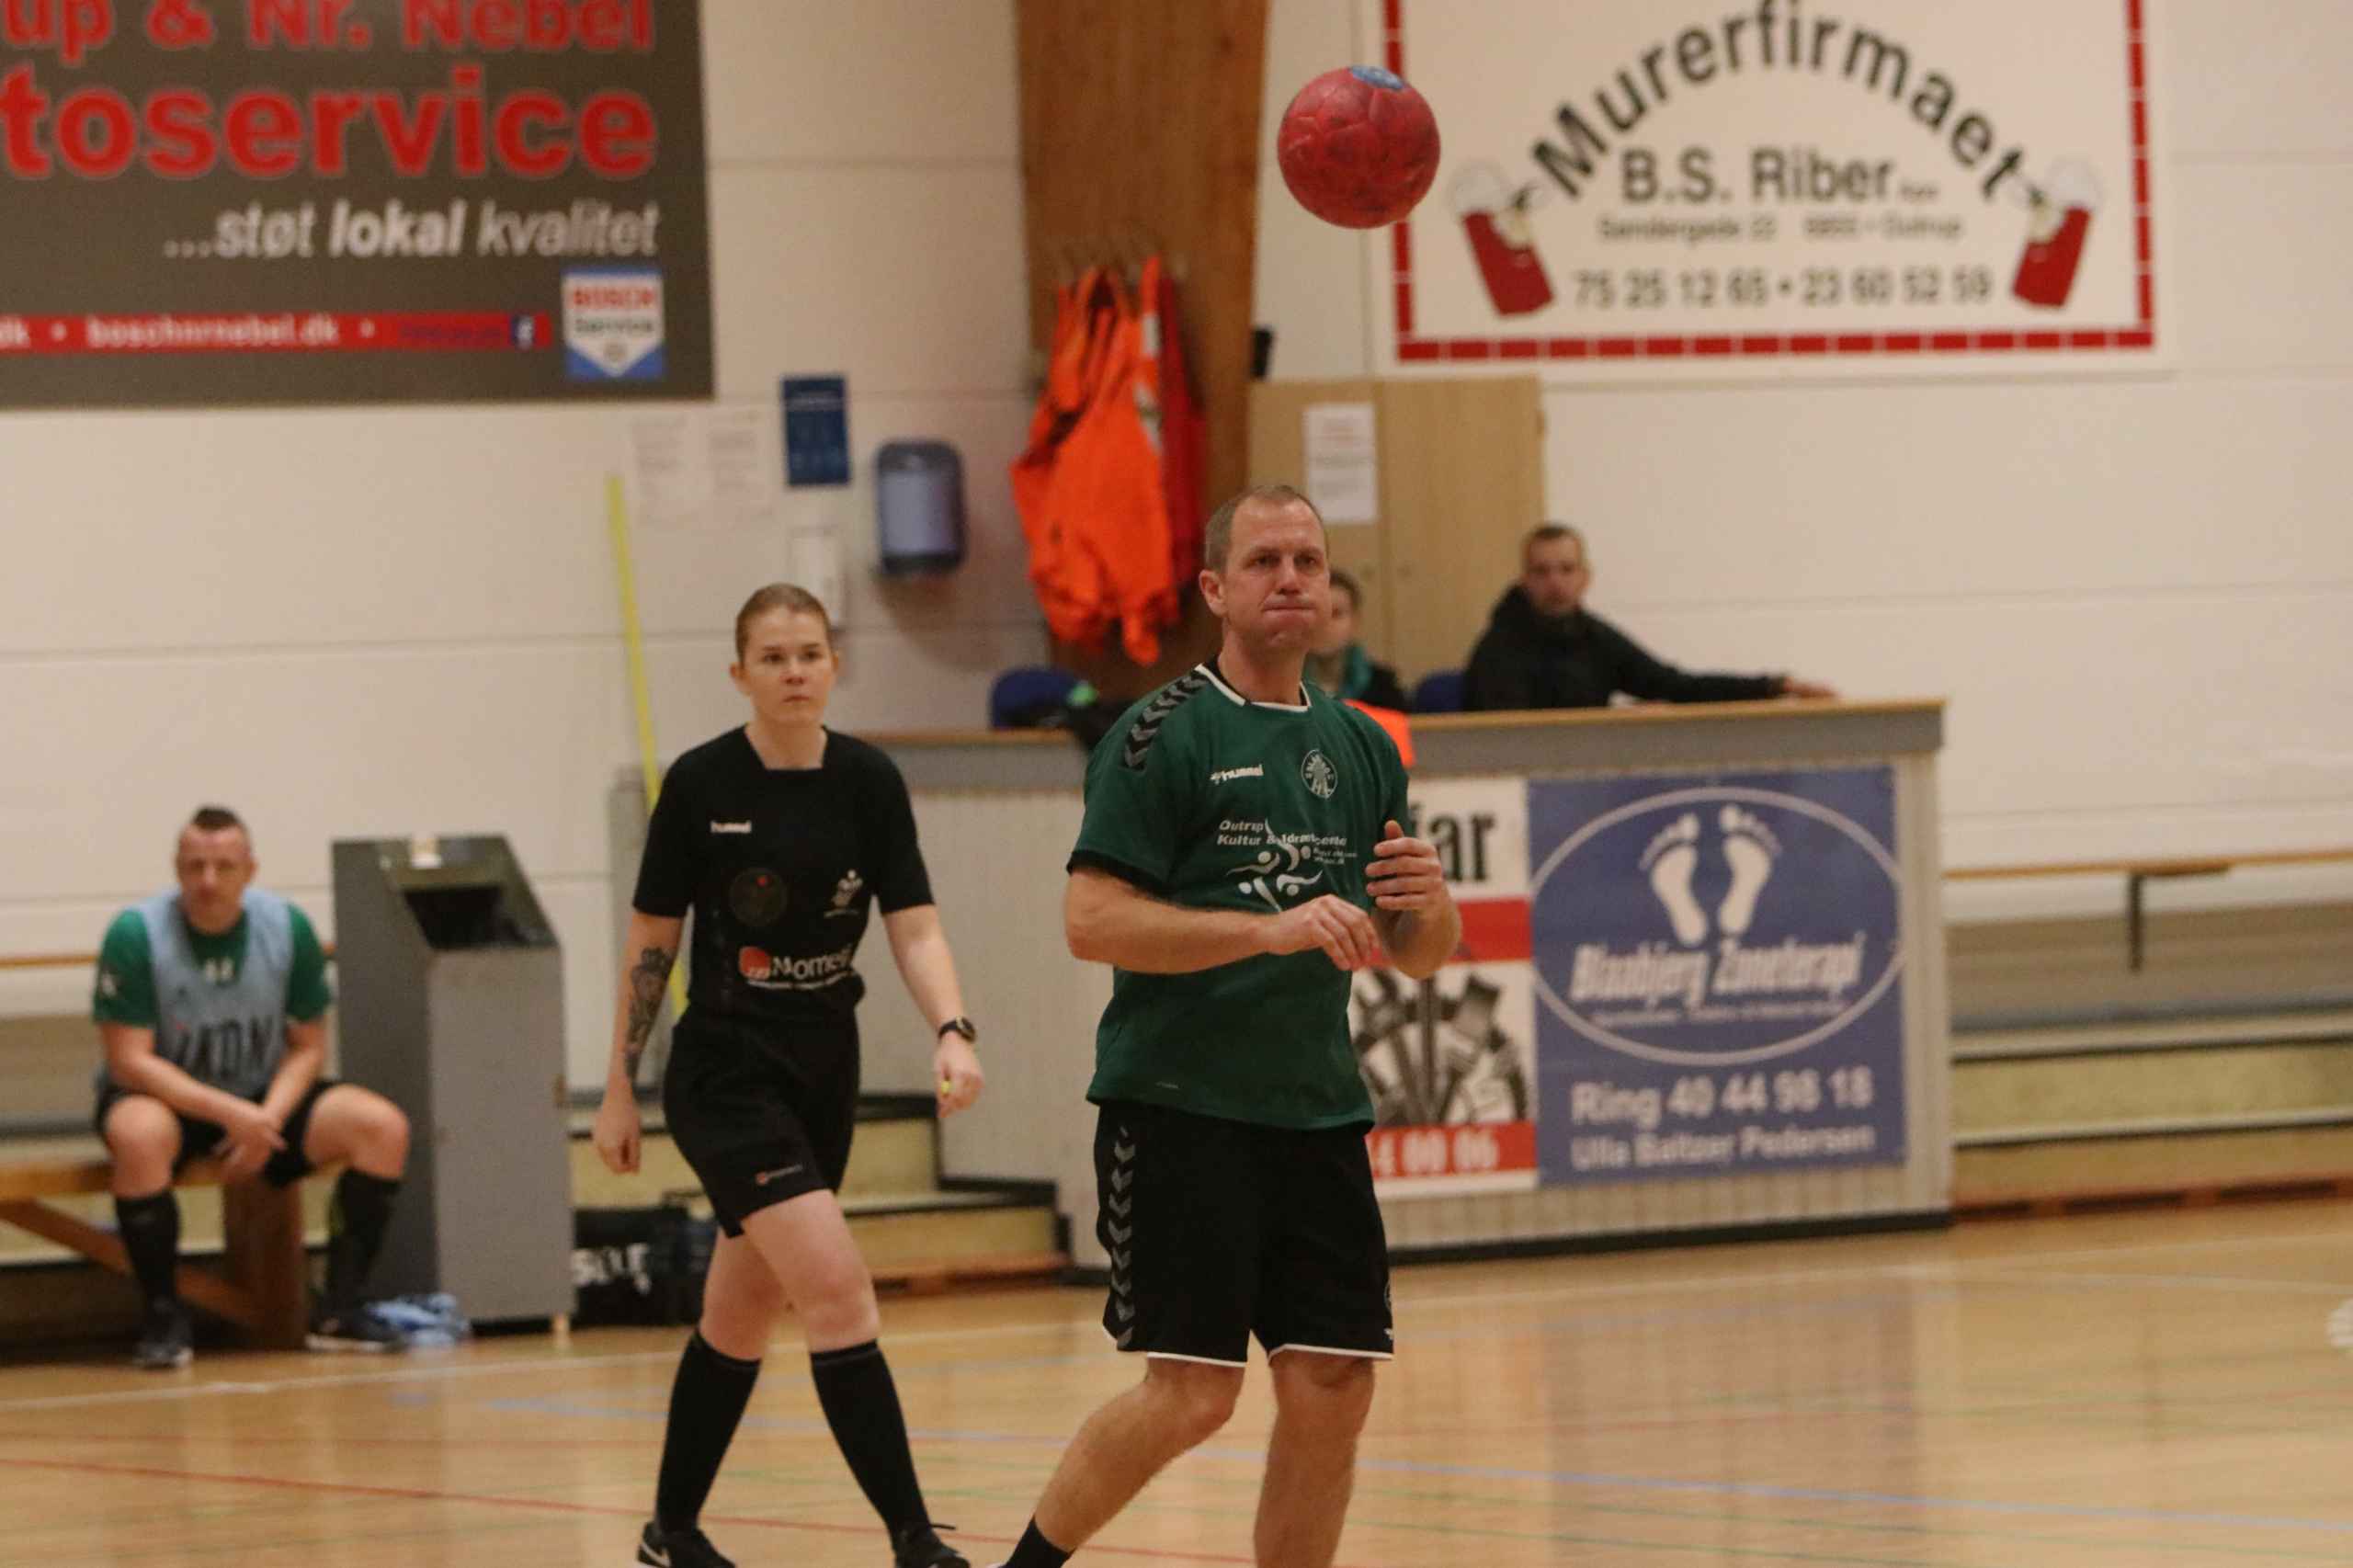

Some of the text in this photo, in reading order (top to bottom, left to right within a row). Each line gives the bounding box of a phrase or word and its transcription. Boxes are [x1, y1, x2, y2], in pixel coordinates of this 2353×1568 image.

[146, 0, 212, 48] &
[247, 0, 370, 48] Nr.
[404, 0, 654, 48] Nebel
[0, 62, 655, 176] toservice
[1529, 0, 2022, 199] Murerfirmaet
[1620, 147, 1733, 204] B.S.
[1749, 147, 1893, 203] Riber
[328, 198, 466, 258] lokal
[475, 197, 659, 258] kvalitet
[1217, 834, 1262, 846] Kultur
[1570, 1079, 1661, 1132] Ring
[1720, 1072, 1768, 1112] 44
